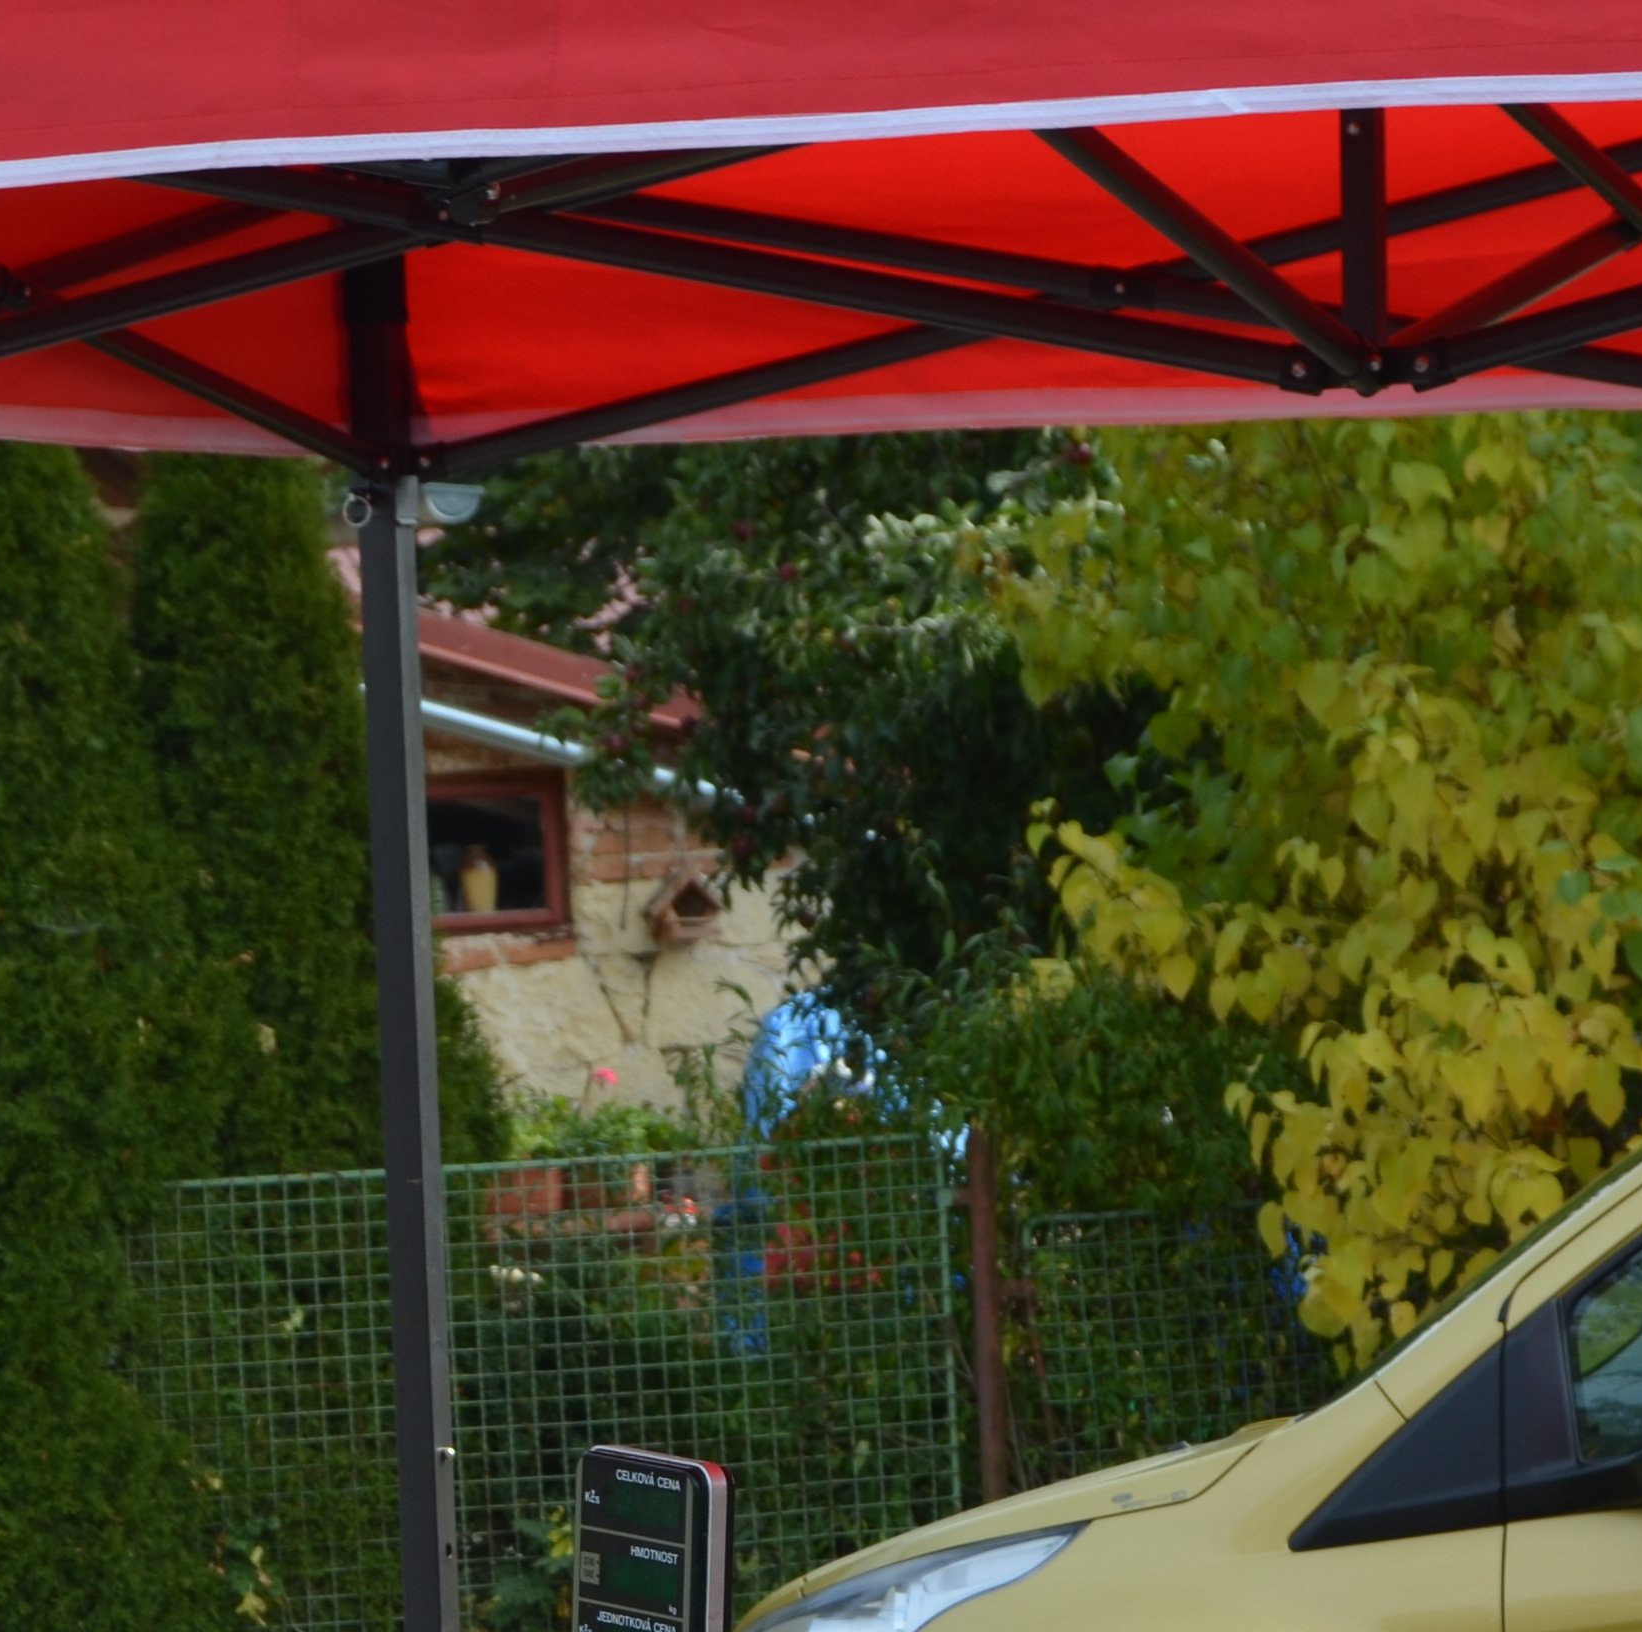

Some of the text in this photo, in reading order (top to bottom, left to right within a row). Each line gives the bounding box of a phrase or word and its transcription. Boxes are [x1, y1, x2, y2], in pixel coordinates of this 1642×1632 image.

[615, 1467, 681, 1492] CELKOVÁ CENA
[630, 1545, 679, 1565] HMOTNOST
[668, 1605, 677, 1615] kg
[596, 1611, 651, 1632] JEDNOTKOVÁ
